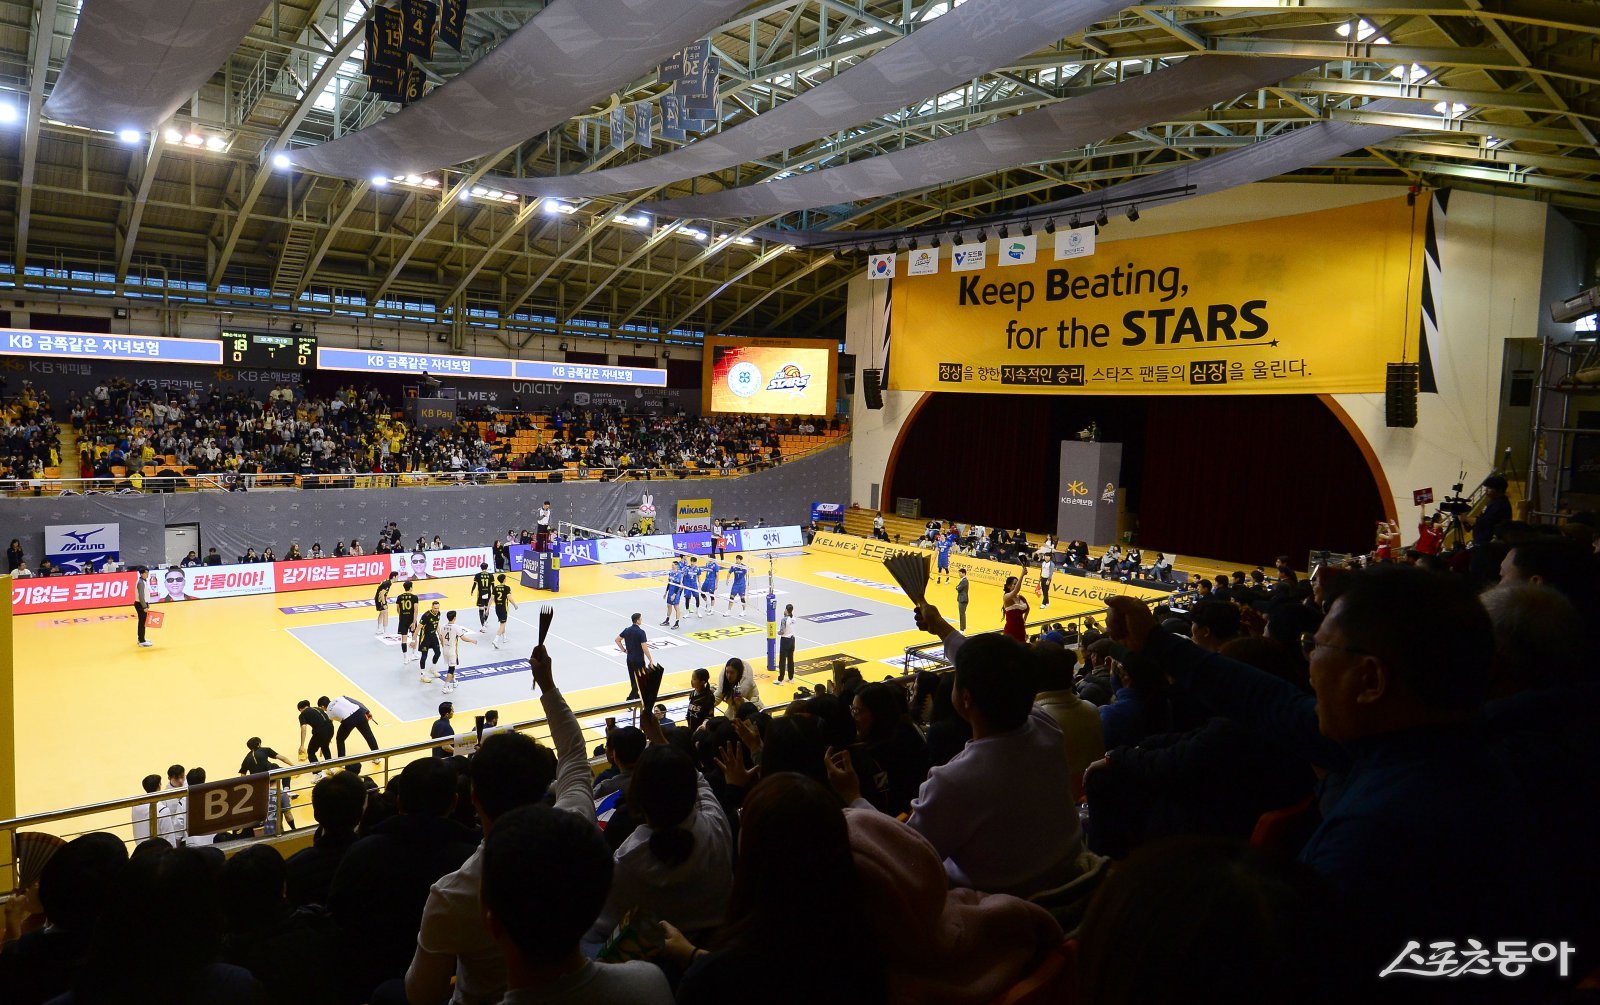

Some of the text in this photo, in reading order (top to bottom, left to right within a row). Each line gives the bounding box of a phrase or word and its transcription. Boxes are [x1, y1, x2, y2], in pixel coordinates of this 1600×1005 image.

[413, 19, 423, 35] 4
[385, 29, 400, 48] 15
[409, 83, 417, 97] 6
[959, 262, 1188, 311] Keep Beating,
[1006, 300, 1269, 349] for the STARS
[9, 335, 159, 355] KB 금쪽같은 자녀보험
[298, 343, 311, 355] 15
[233, 351, 241, 361] 0
[298, 355, 306, 365] 0
[367, 355, 471, 372] KB 금쪽같은 자녀보험
[552, 366, 633, 382] KB 금쪽같은 자녀보험
[939, 358, 1312, 384] 정상을 향한 지속적인 승리, 스타즈 팬들의 심장을 울린다.
[512, 382, 562, 395] UNICITY
[768, 376, 809, 389] STARS
[421, 409, 453, 420] KB Pay
[225, 475, 236, 484] C2
[60, 543, 105, 551] MIZUNO
[762, 532, 780, 547] 잇치
[815, 536, 851, 551] KELME
[564, 543, 591, 563] 잇치
[624, 543, 646, 558] 잇치
[432, 553, 486, 571] 판콜이야!
[973, 564, 992, 574] 스타즈
[282, 561, 384, 584] 감기없는 코리아
[193, 570, 265, 591] 판콜이야!
[480, 579, 489, 588] 11
[1023, 577, 1040, 588] 도드
[12, 580, 129, 605] 기없는 코리아
[497, 591, 503, 601] 2
[401, 599, 412, 611] 10
[444, 632, 450, 642] 4
[204, 783, 255, 821] B2
